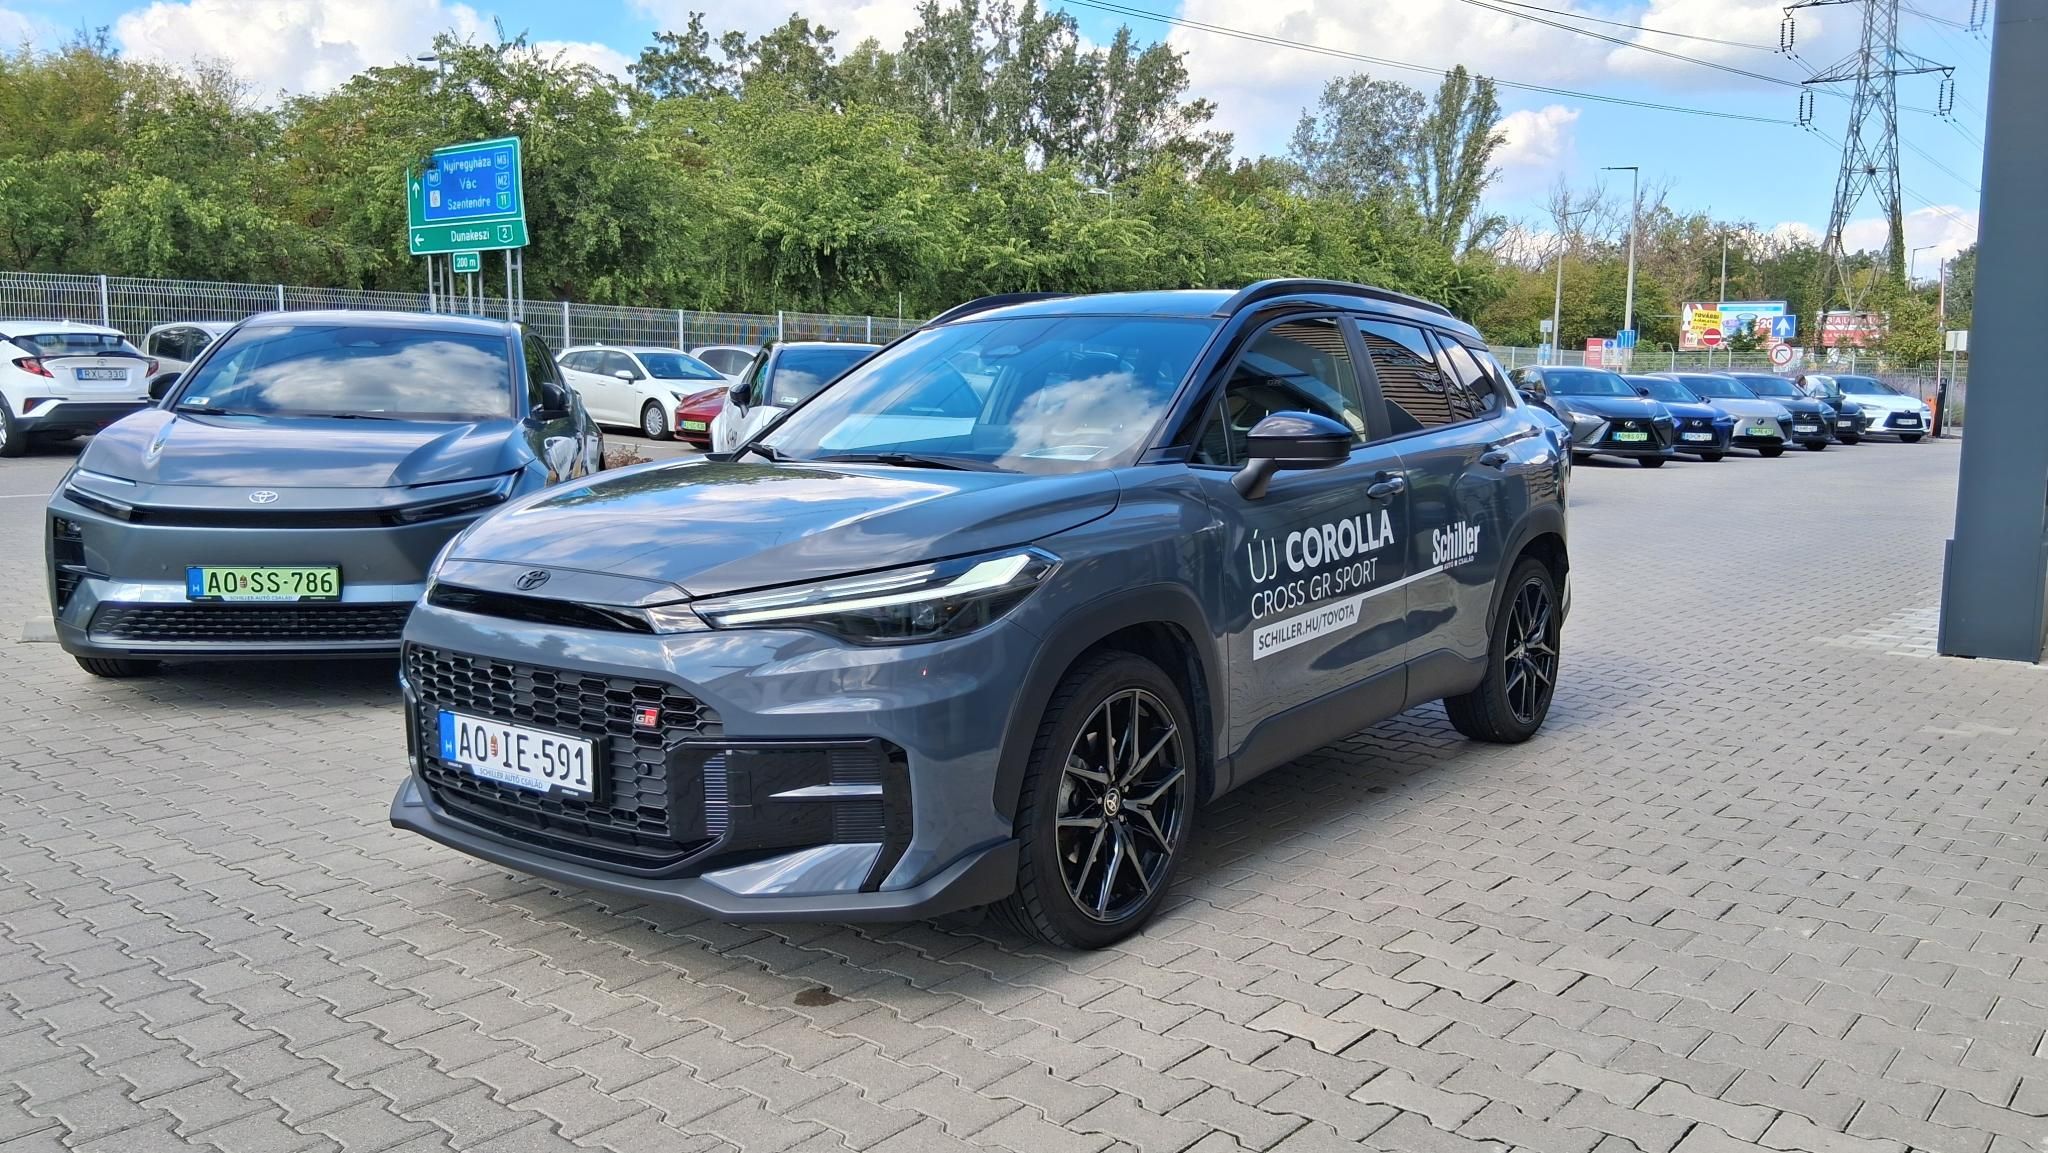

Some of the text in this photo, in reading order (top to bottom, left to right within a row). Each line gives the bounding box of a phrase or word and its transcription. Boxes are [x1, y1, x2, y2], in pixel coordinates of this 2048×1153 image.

[496, 154, 507, 165] M3
[459, 177, 477, 190] Vác
[497, 175, 508, 186] M2
[447, 196, 491, 211] Szentendre
[500, 194, 508, 206] 11
[450, 227, 490, 243] Dunakeszi
[501, 227, 508, 239] 2
[456, 257, 476, 268] 200 m
[1247, 509, 1395, 584] ÚJ COROLLA
[1432, 520, 1481, 566] Schiller
[192, 583, 200, 592] H
[207, 571, 333, 594] AO SS-786
[1251, 557, 1378, 620] CROSS GR SPORT
[1258, 605, 1355, 651] SCHILLER.HU/TOYOTA
[636, 713, 656, 726] GR
[445, 742, 453, 753] H
[459, 721, 587, 786] AO IE-591
[479, 767, 543, 789] SCHILLER AUTÓ CSALÁD
